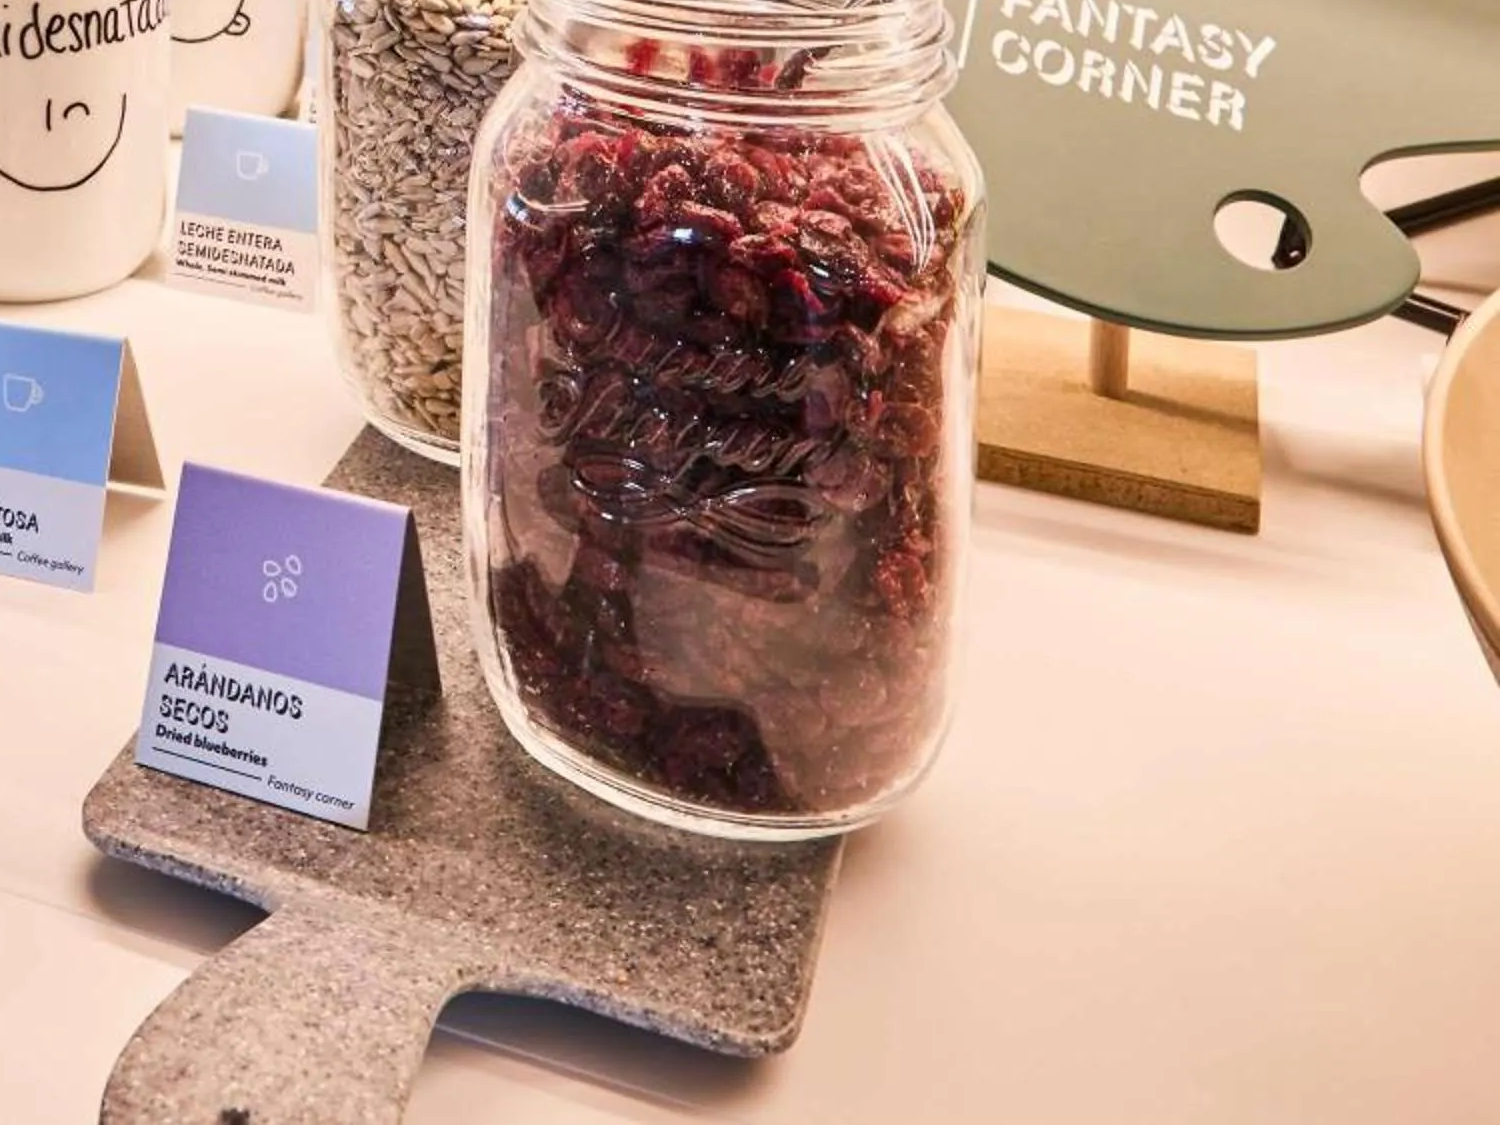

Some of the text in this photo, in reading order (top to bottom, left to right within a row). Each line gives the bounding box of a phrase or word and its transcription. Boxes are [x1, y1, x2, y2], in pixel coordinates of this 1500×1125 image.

[991, 28, 1248, 132] CORNER
[179, 220, 283, 251] LECHE ENTERA
[16, 550, 50, 567] Coffee
[163, 662, 303, 719] ARÁNDANOS
[158, 694, 229, 733] SECOS
[155, 723, 269, 767] Dried blueberries
[266, 774, 356, 810] Fantasy corner
